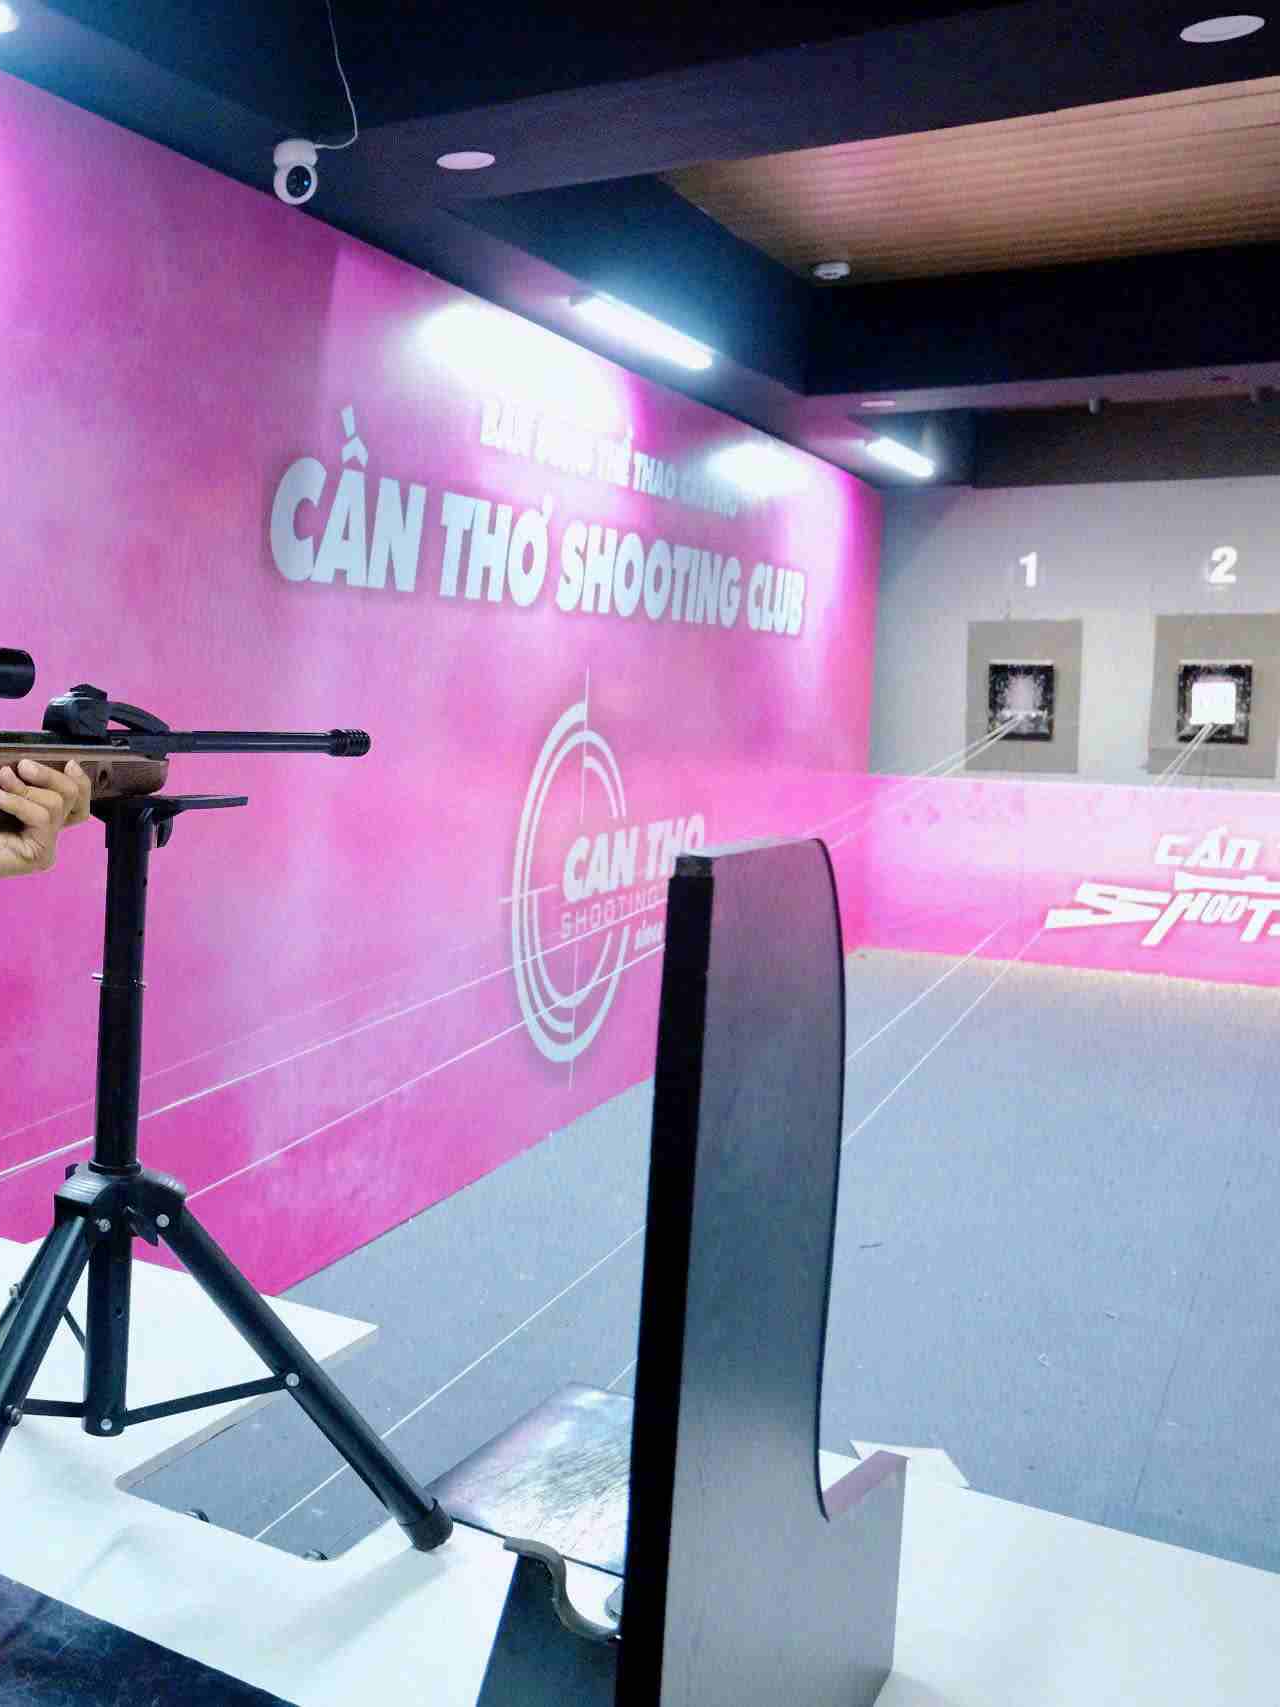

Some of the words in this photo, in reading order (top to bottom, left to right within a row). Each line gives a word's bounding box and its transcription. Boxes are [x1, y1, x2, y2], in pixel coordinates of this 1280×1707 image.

[270, 405, 427, 592] CẦN
[439, 491, 552, 607] THƠ
[556, 521, 741, 628] SHOOTING
[748, 562, 805, 636] CLUB
[1019, 551, 1038, 587] 1
[1208, 546, 1238, 584] 2
[563, 825, 639, 904] CAN
[1043, 871, 1280, 947] SHOOT
